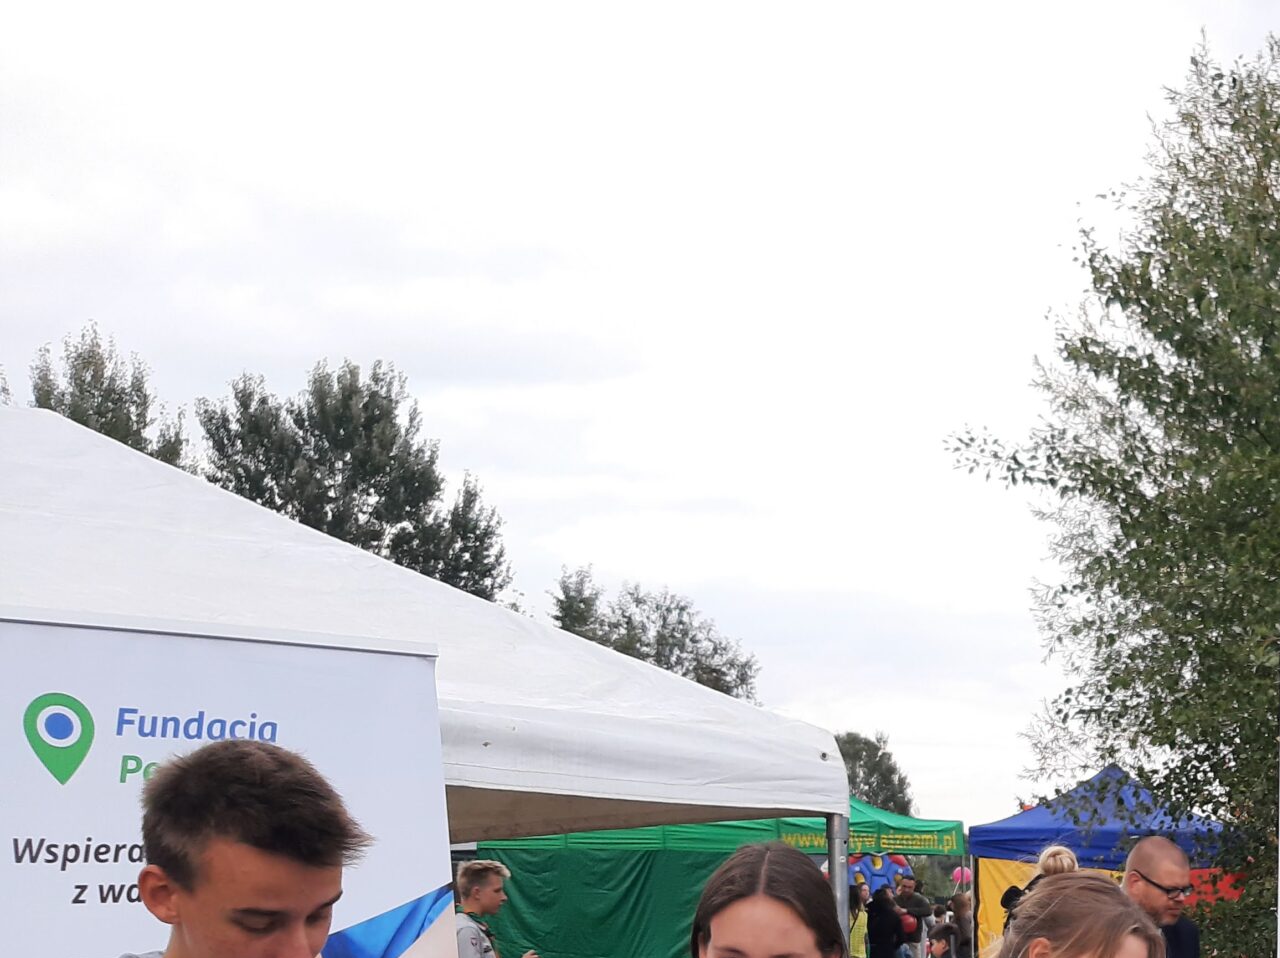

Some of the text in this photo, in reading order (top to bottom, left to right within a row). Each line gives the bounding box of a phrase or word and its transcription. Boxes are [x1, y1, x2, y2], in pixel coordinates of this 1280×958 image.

[13, 837, 145, 871] Wspiera
[72, 881, 142, 904] z wa
